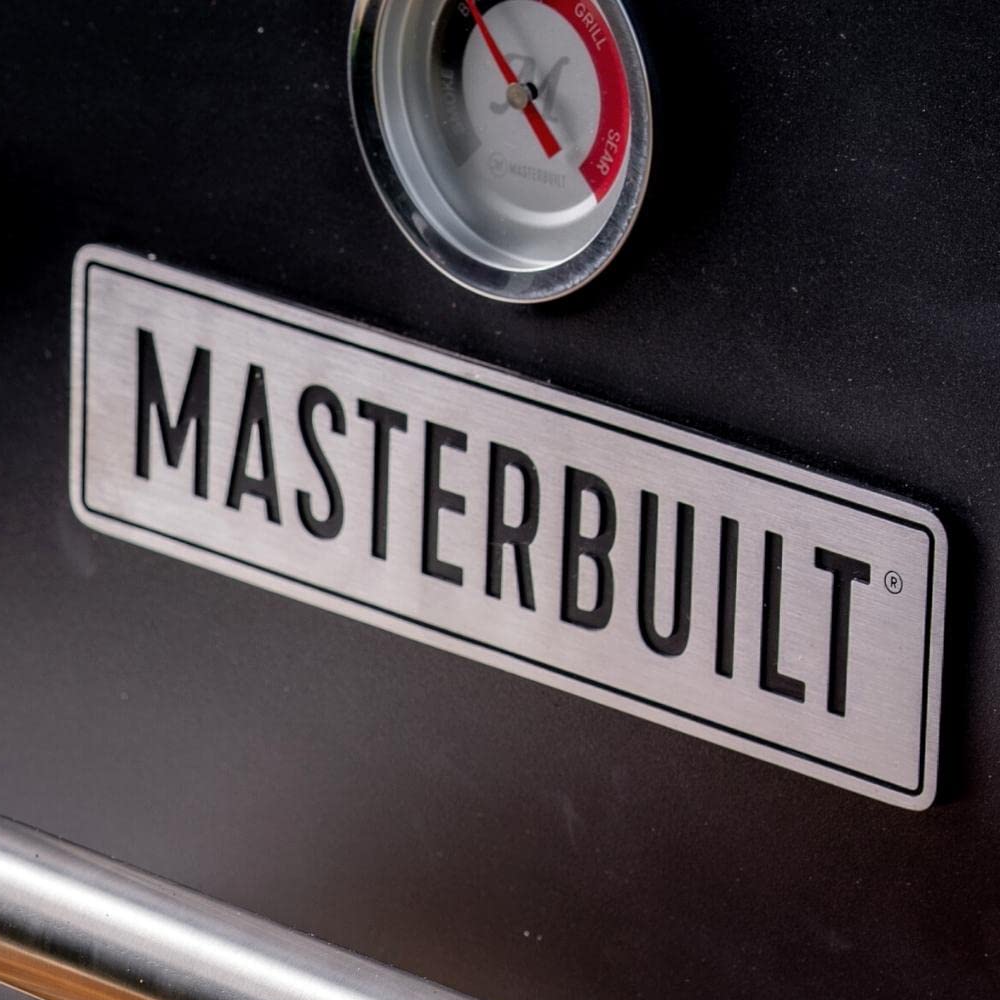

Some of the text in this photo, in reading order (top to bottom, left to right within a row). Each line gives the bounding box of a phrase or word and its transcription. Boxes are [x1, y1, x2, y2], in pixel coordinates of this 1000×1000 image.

[574, 2, 608, 51] GRILL
[596, 128, 621, 176] SEAR
[134, 327, 871, 718] MASTERBUILT
